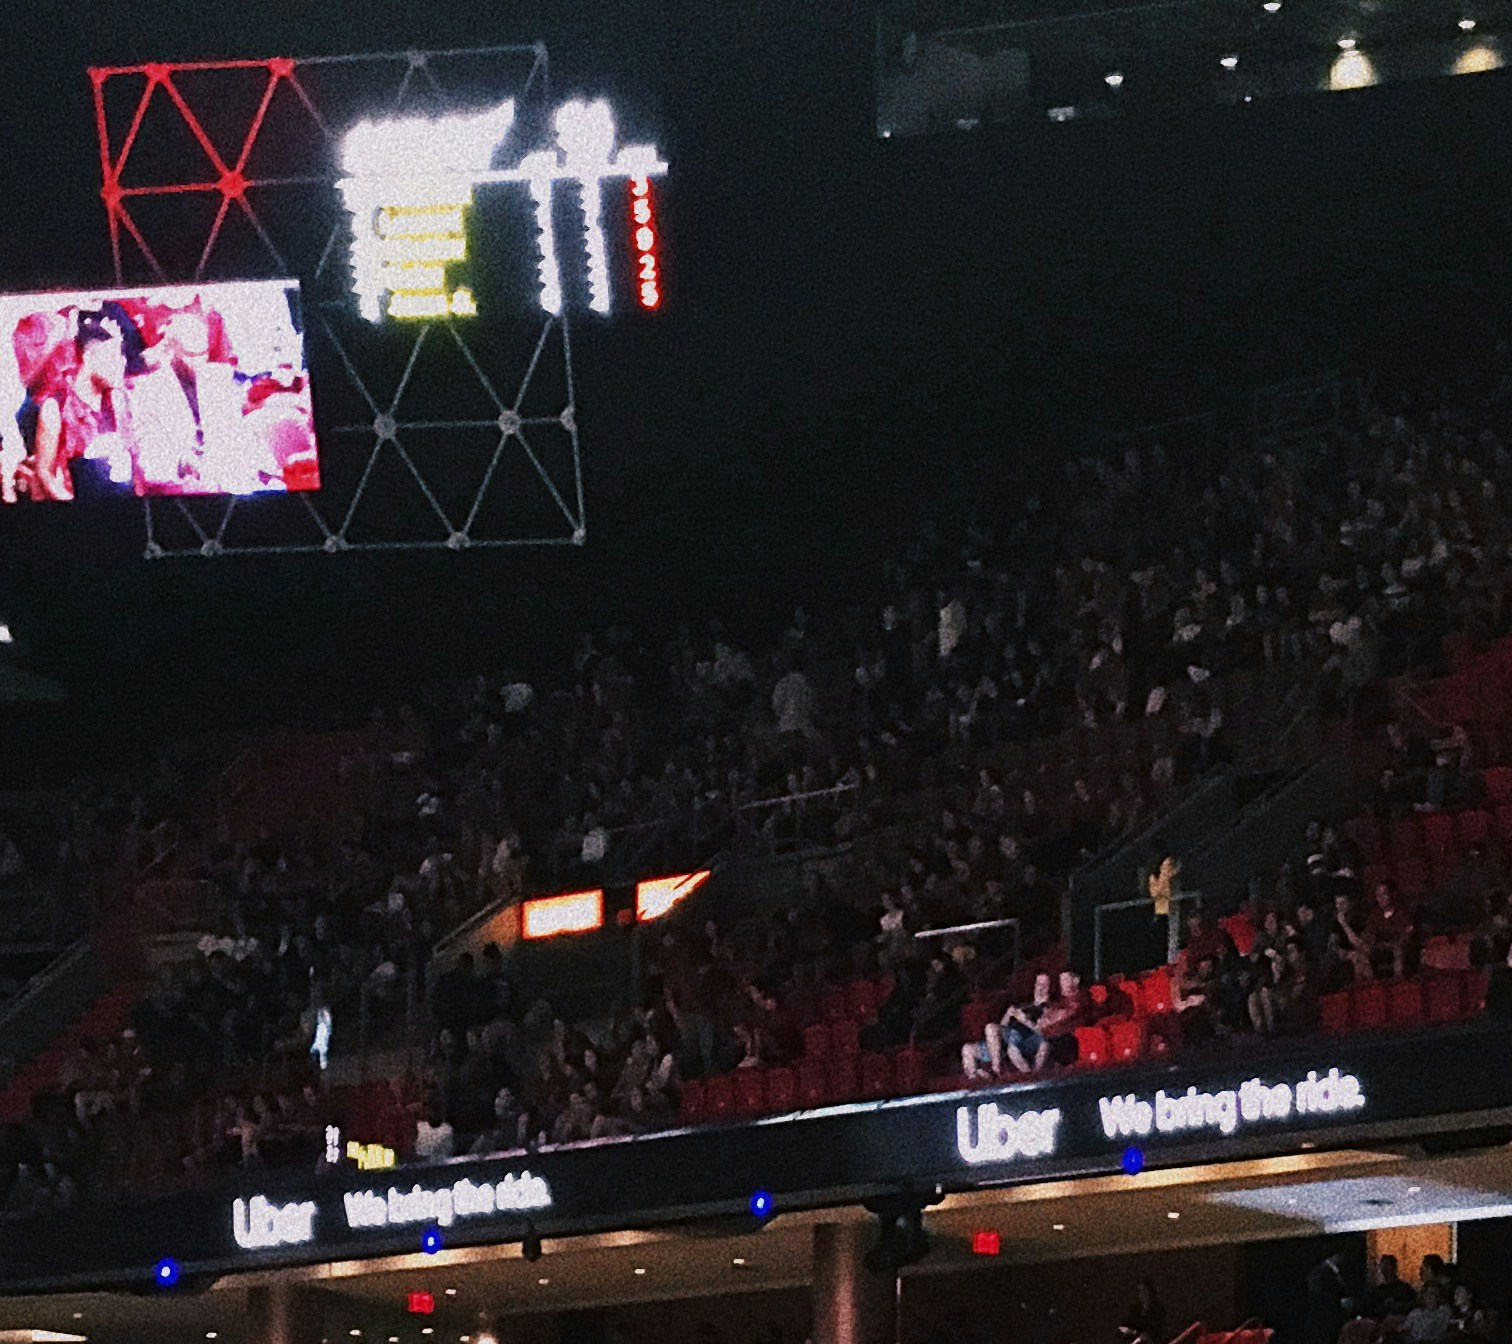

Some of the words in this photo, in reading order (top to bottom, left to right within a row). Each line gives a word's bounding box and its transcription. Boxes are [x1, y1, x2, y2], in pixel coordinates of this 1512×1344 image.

[956, 1102, 1061, 1163] Uber
[1099, 1093, 1153, 1138] We
[1155, 1085, 1238, 1134] bring
[1238, 1077, 1293, 1121] the
[232, 1194, 317, 1249] Uber
[343, 1190, 388, 1228] We
[388, 1184, 452, 1227] bring
[453, 1177, 495, 1215] the
